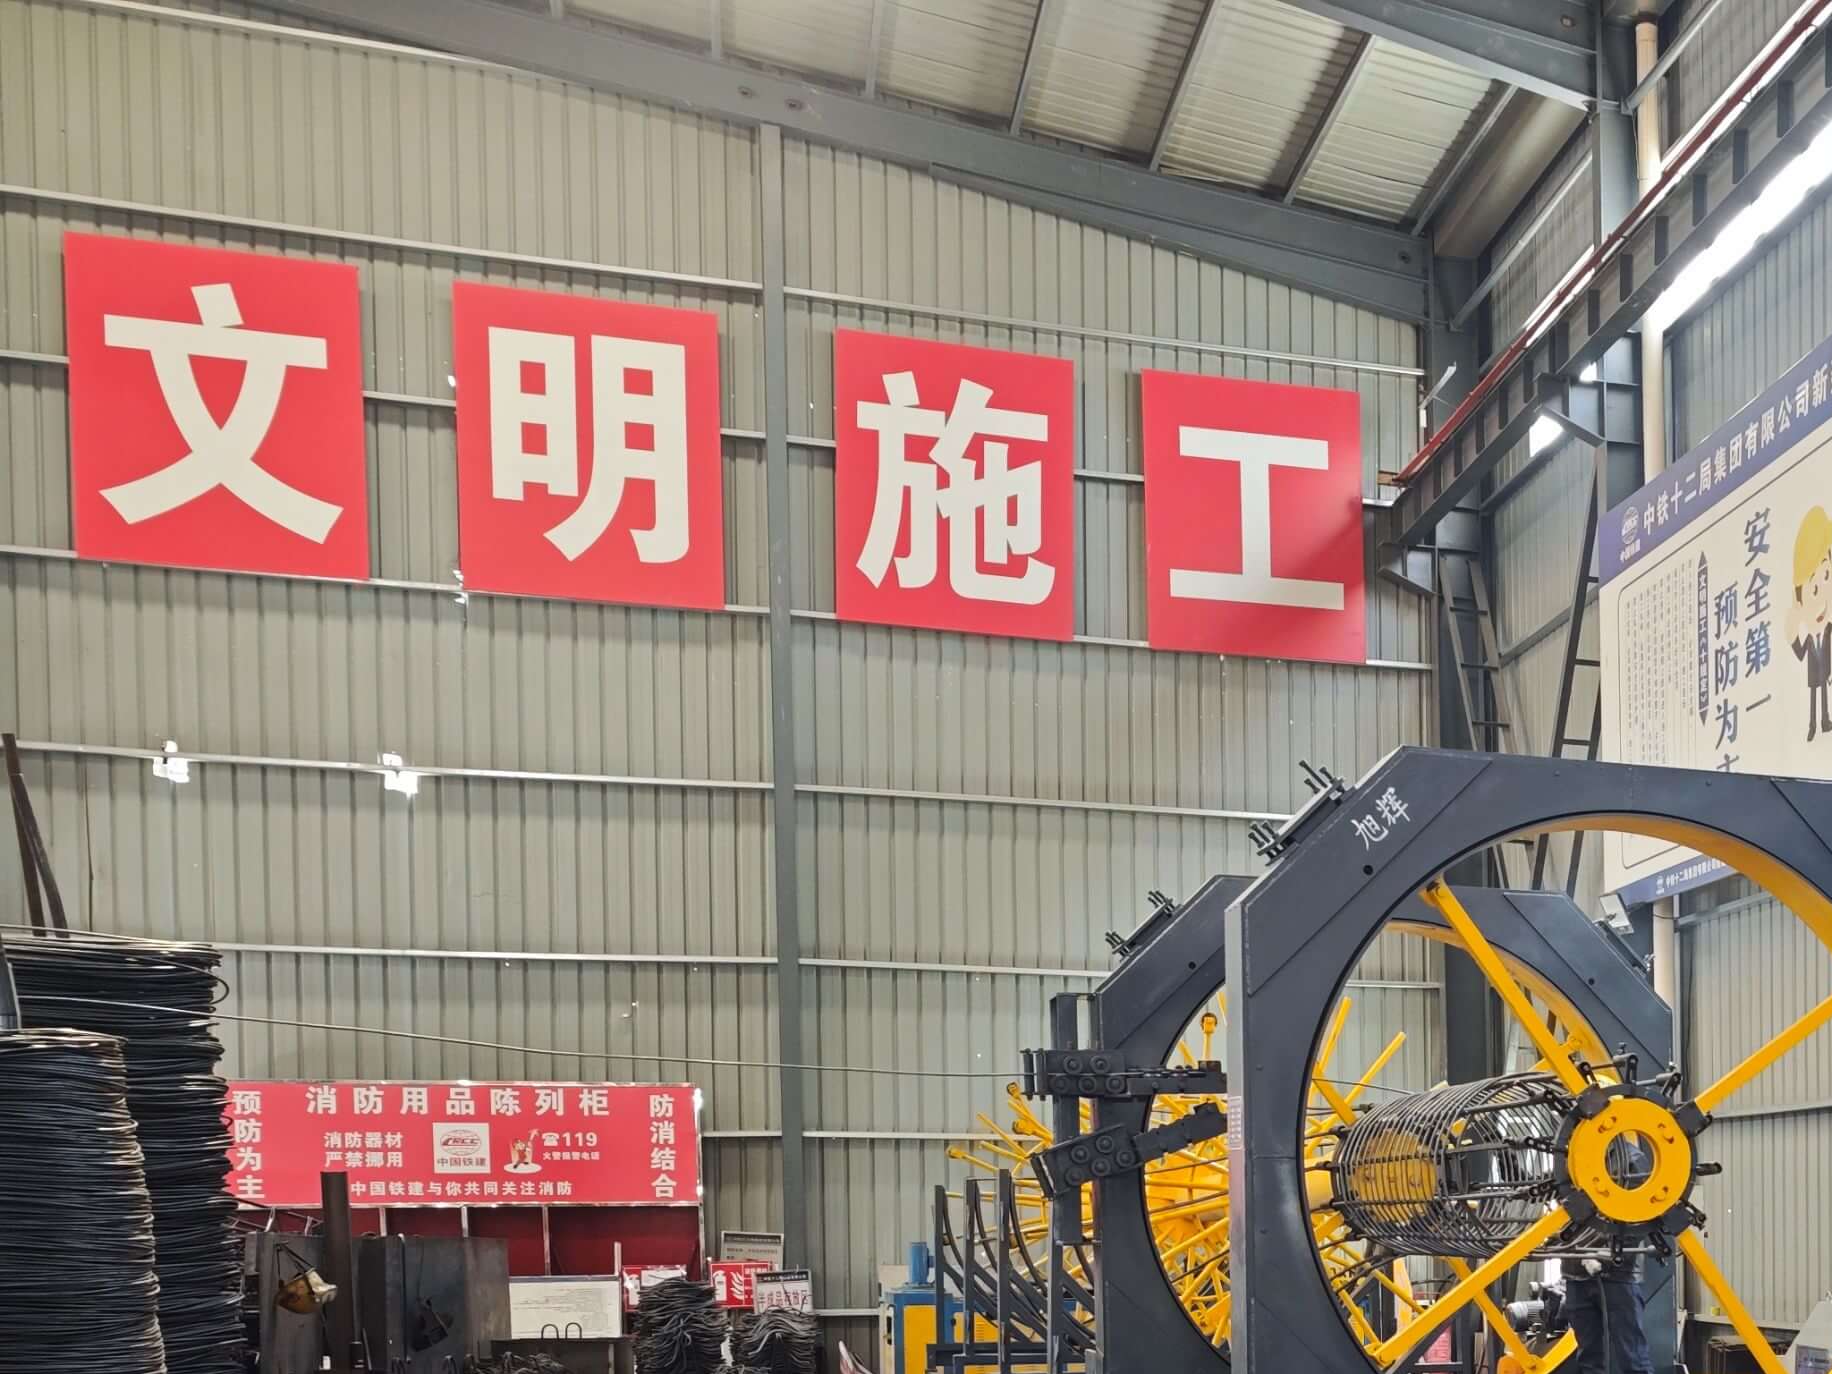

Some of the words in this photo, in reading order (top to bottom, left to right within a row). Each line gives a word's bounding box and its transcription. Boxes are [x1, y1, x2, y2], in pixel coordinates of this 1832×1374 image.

[99, 283, 1347, 613] 文明施工
[1744, 507, 1772, 712] 安全第一
[1350, 786, 1411, 852] 旭辉
[305, 1086, 610, 1117] 消防用品陈列柜
[231, 1090, 265, 1200] 预防为主
[323, 1132, 404, 1149] 消防器材
[324, 1151, 404, 1168] 严禁挪用
[562, 1131, 598, 1147] 119
[648, 1094, 678, 1198] 防消结合
[350, 1180, 573, 1197] 中国铁建与你共同关注消防
